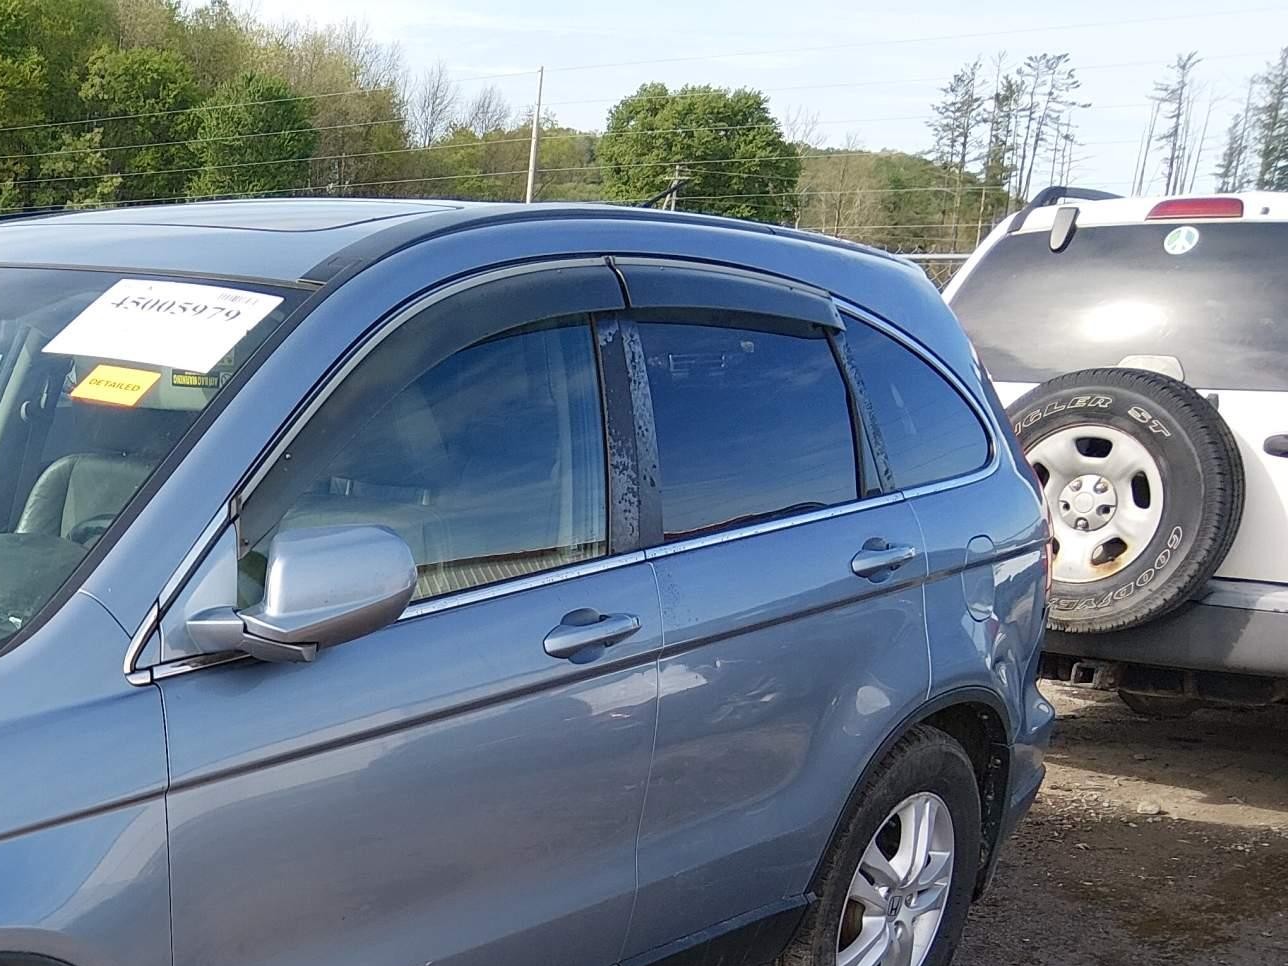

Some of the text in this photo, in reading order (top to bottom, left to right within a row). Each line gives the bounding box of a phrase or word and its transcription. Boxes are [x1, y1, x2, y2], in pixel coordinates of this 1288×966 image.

[111, 295, 242, 322] 45005979
[88, 378, 141, 392] DETAILED
[1127, 405, 1171, 437] ST
